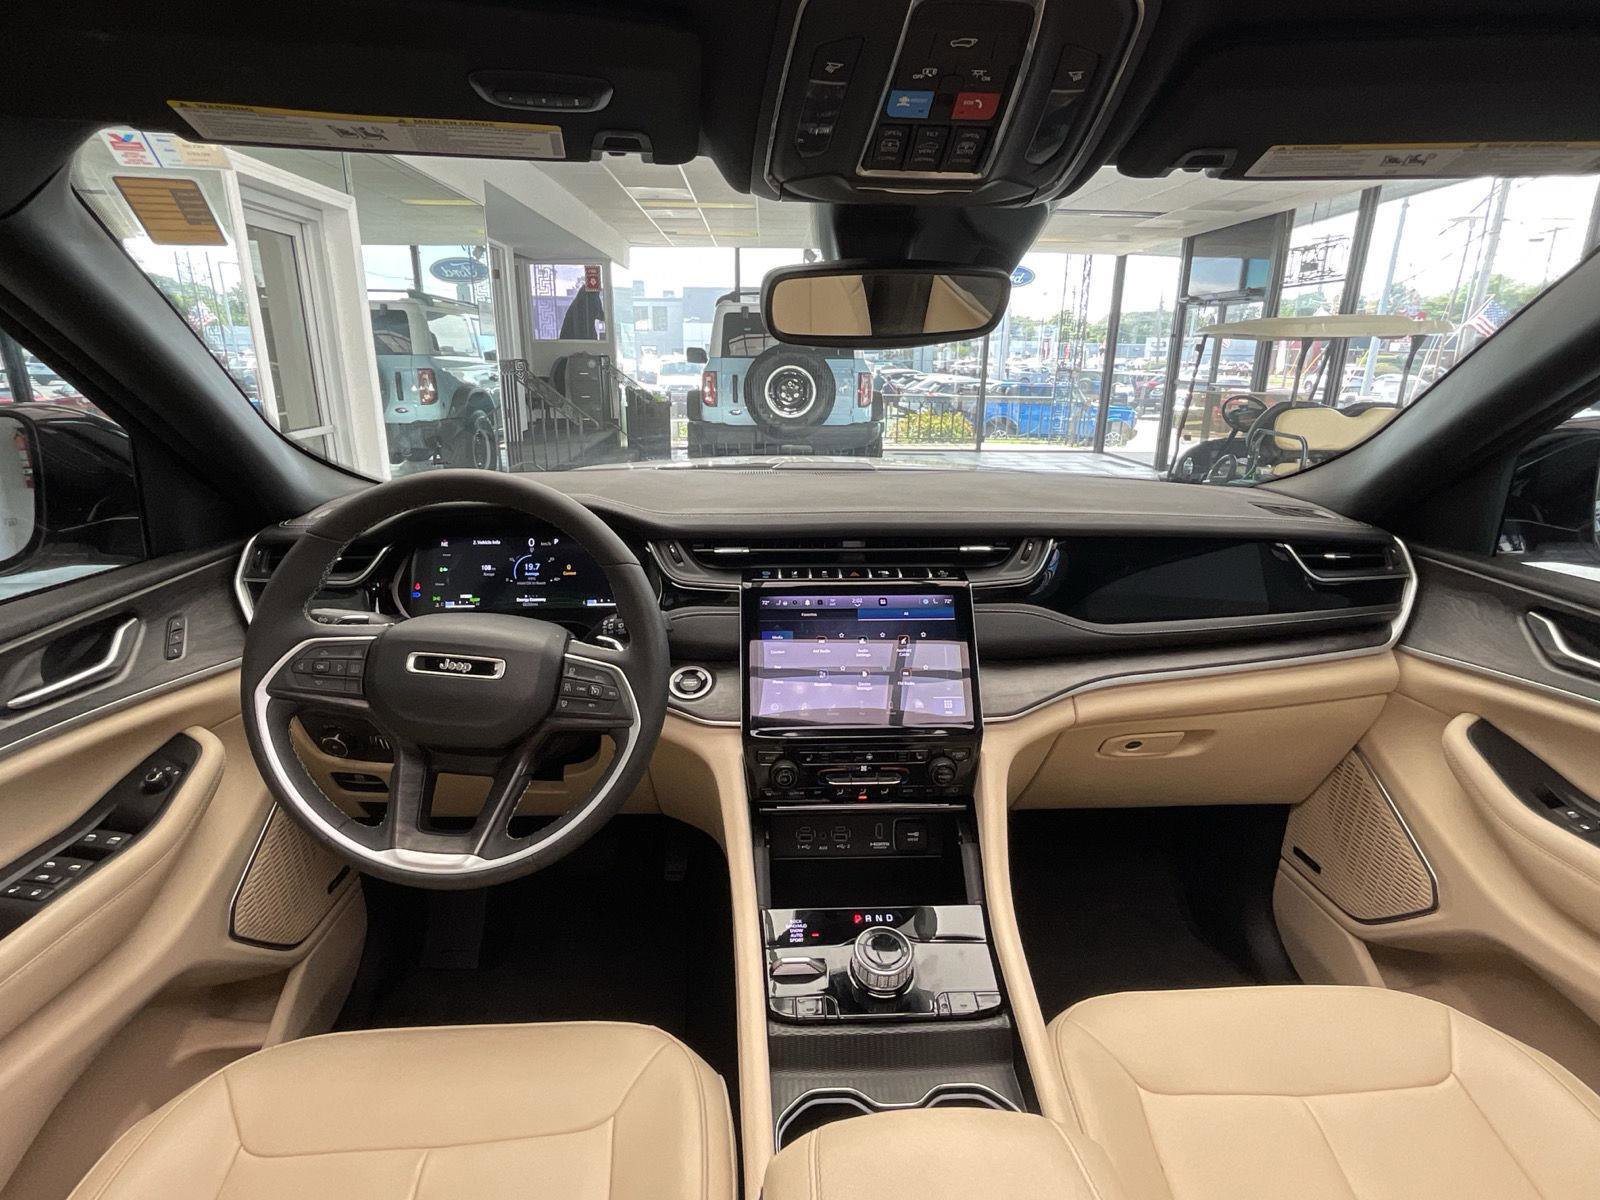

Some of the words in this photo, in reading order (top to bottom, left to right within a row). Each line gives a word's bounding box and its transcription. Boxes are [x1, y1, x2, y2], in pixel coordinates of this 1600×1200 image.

[528, 538, 535, 547] 0
[524, 563, 541, 571] 19.7
[439, 658, 472, 673] Jeep
[854, 915, 863, 923] P
[886, 914, 894, 922] D
